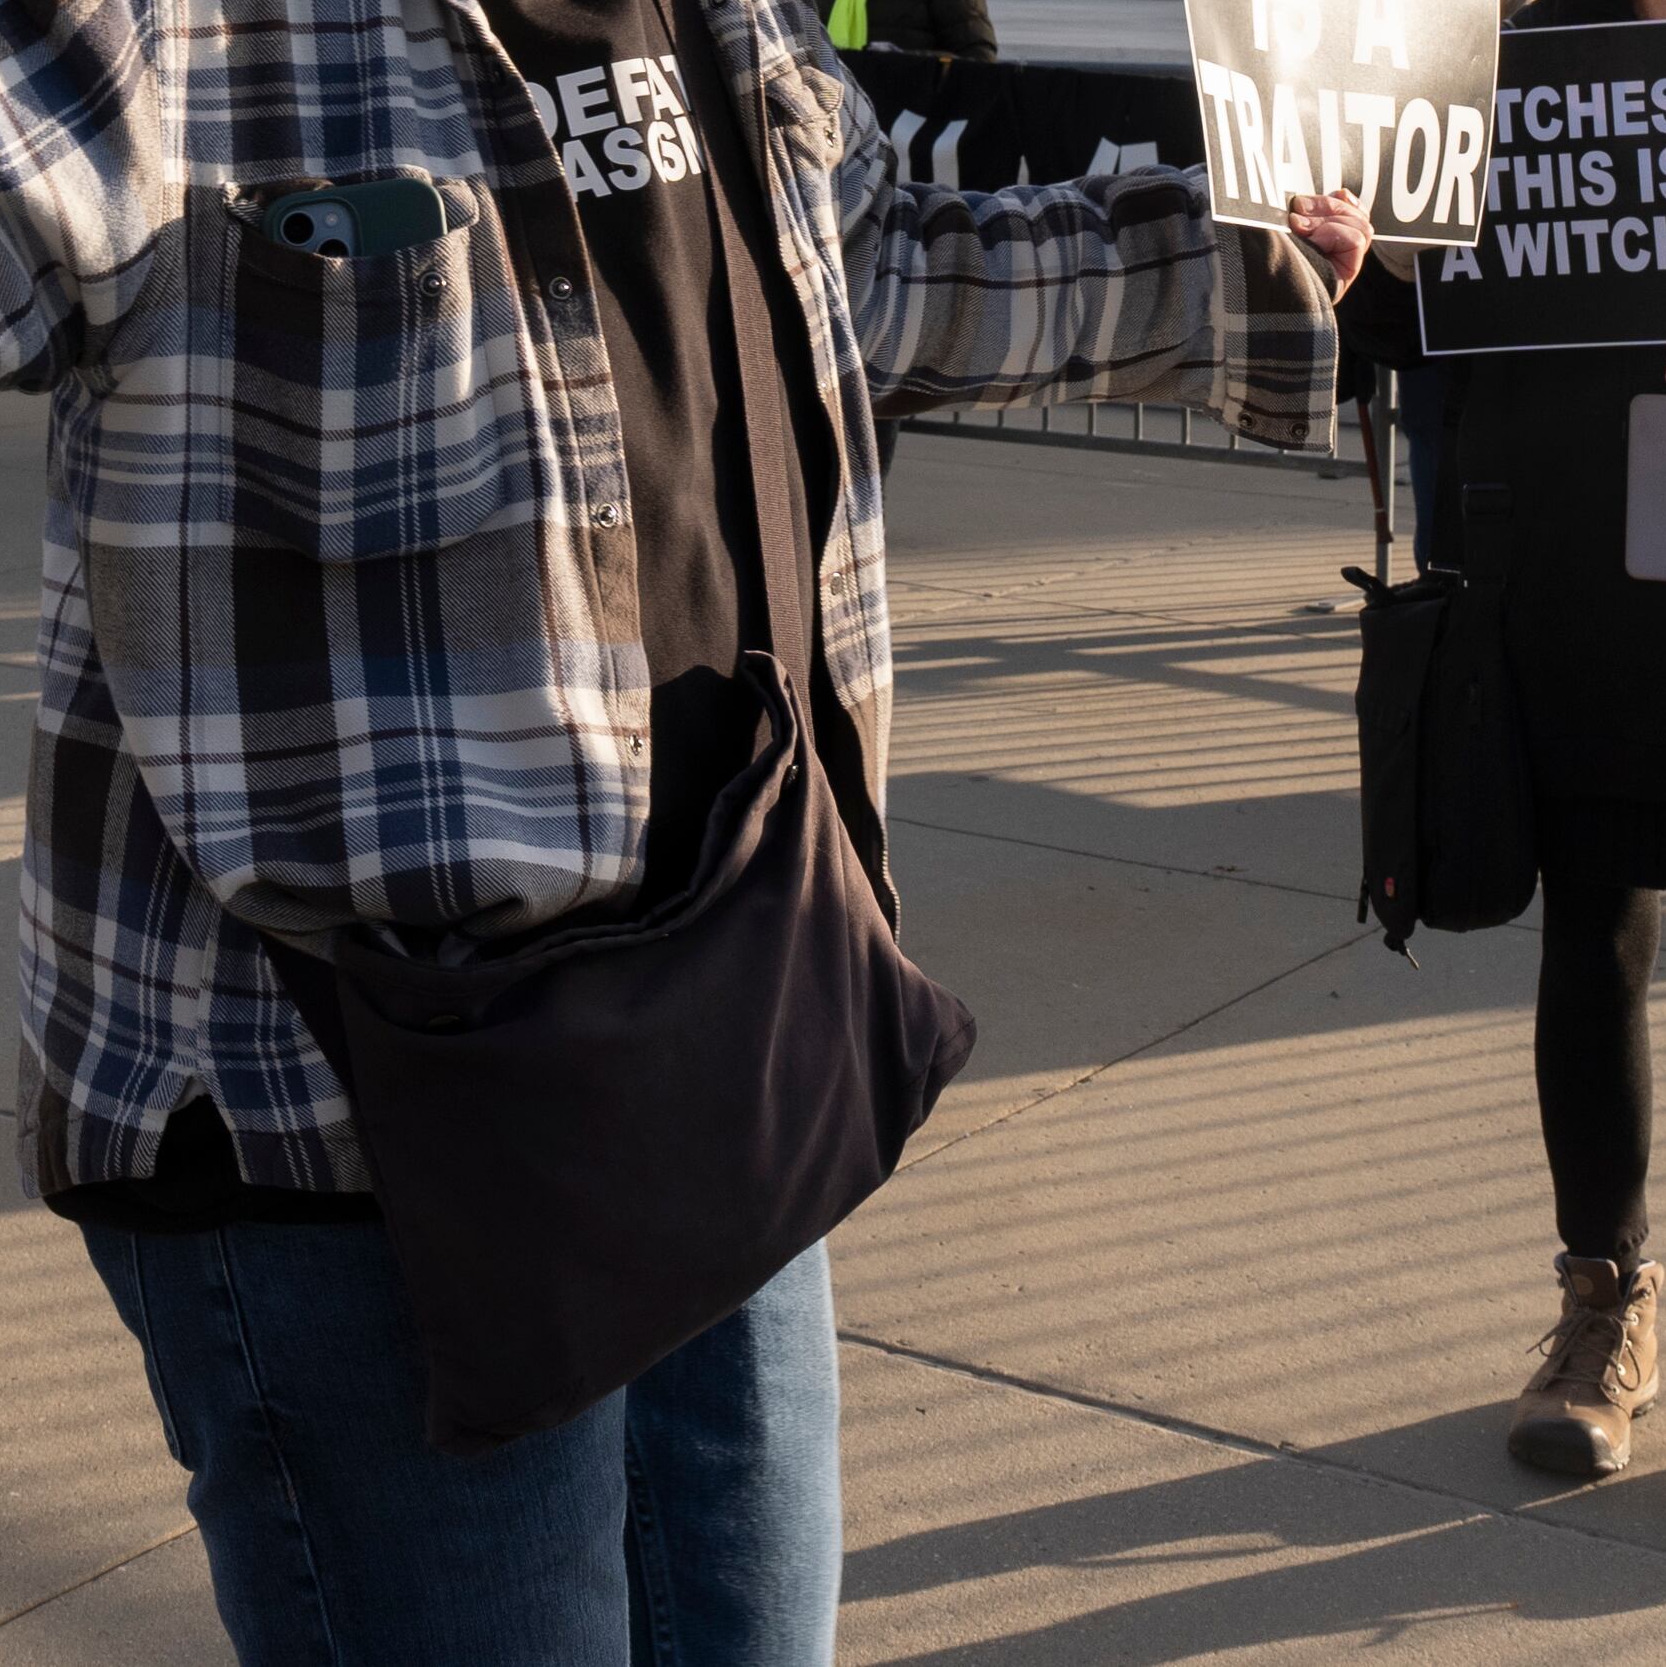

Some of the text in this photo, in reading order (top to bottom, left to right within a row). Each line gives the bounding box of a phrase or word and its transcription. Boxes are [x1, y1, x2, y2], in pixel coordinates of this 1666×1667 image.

[1199, 58, 1485, 226] TRAITOR
[1486, 149, 1617, 212] THIS
[1440, 244, 1483, 283] A
